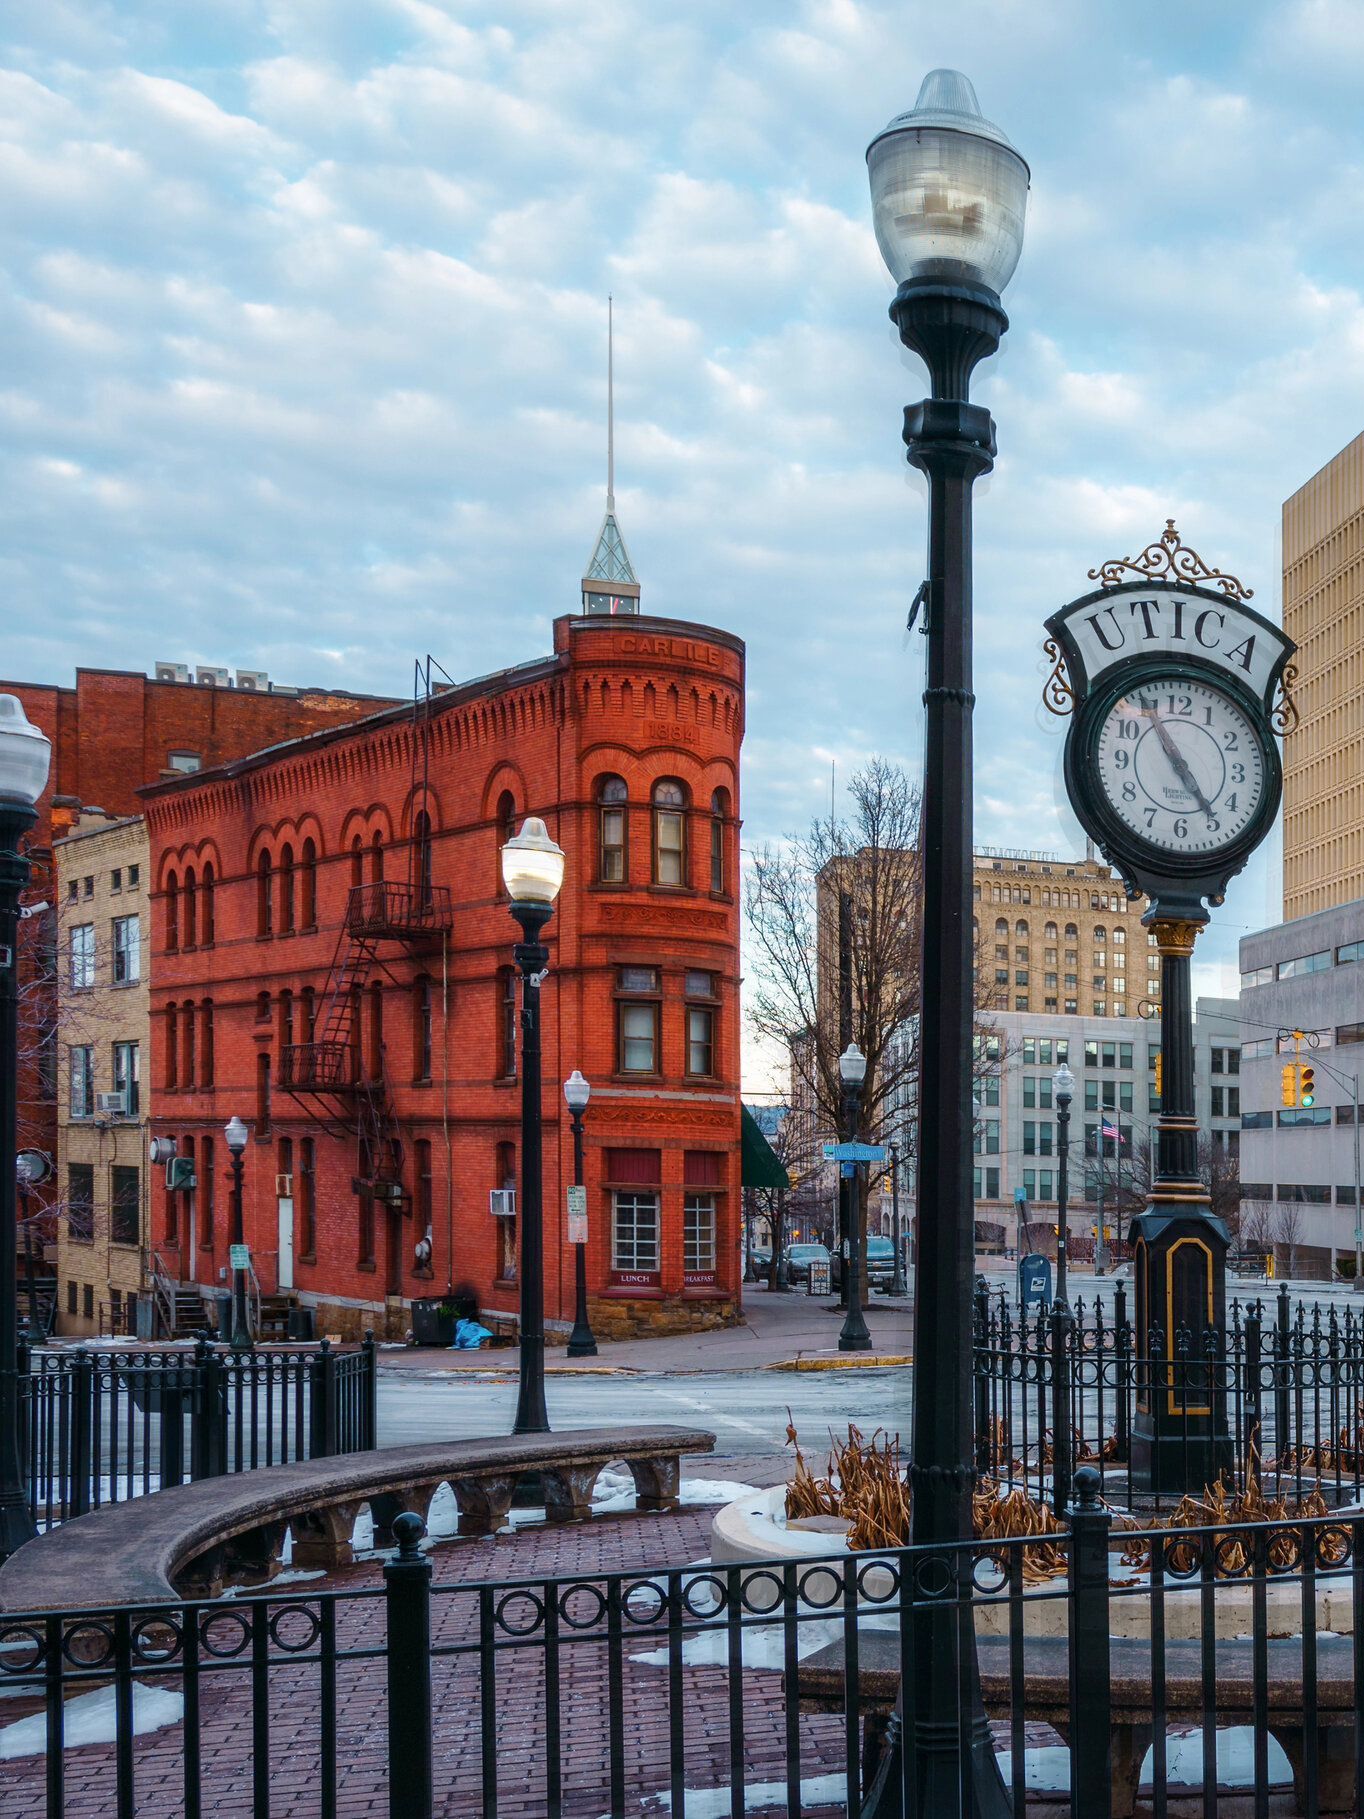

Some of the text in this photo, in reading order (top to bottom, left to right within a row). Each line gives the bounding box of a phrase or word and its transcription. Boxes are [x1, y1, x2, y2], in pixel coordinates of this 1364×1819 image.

[1084, 600, 1257, 674] UTICA
[620, 635, 720, 667] CARLILE
[1165, 695, 1192, 716] 12
[1203, 706, 1215, 726] 1
[649, 721, 696, 745] 1884
[1115, 719, 1140, 740] 10
[1224, 731, 1239, 751] 2
[1114, 750, 1129, 770] 9
[1231, 763, 1245, 783] 3
[1122, 781, 1136, 802] 8
[1224, 793, 1238, 812] 4
[1143, 808, 1158, 828] 7
[1173, 818, 1188, 838] 6
[1206, 812, 1220, 832] 5
